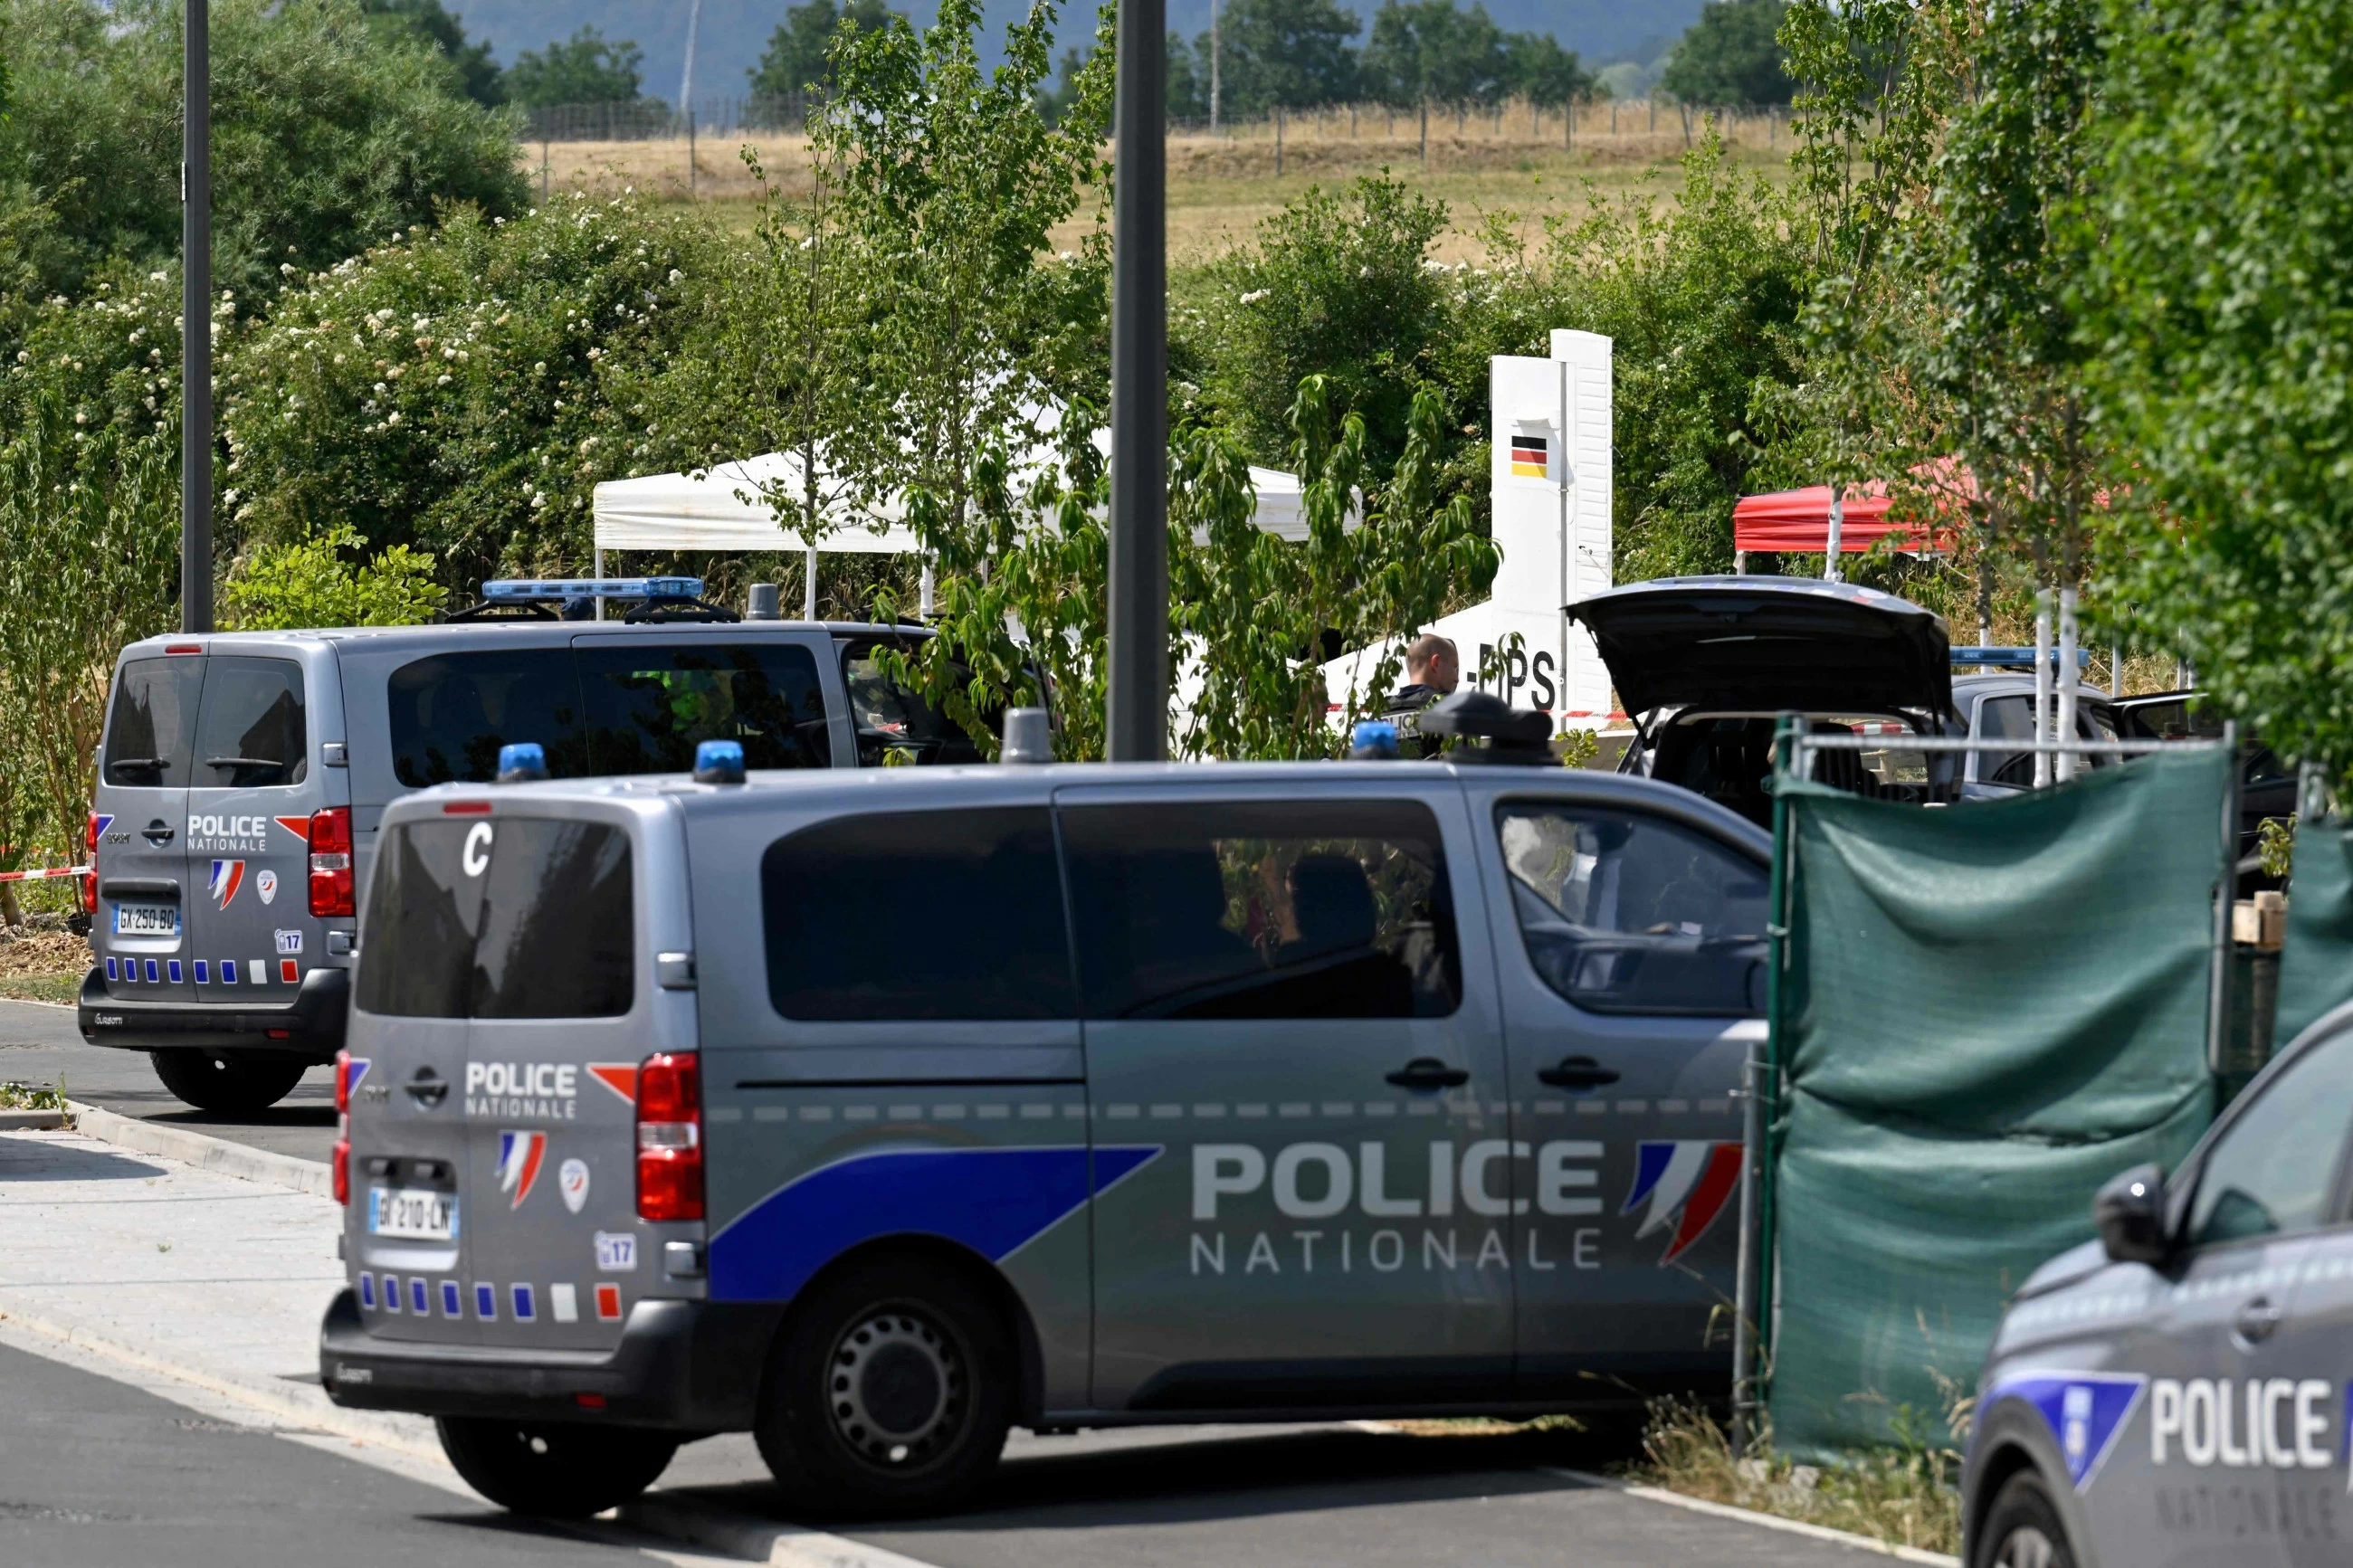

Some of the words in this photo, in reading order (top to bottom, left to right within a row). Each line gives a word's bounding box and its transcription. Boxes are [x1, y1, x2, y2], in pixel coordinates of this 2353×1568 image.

[188, 815, 266, 837] POLICE
[188, 838, 266, 851] NATIONALE
[462, 822, 492, 877] C
[285, 935, 300, 949] 17
[466, 1061, 577, 1098] POLICE
[465, 1097, 576, 1118] NATIONALE
[1193, 1140, 1605, 1220] POLICE
[612, 1241, 632, 1261] 17
[1191, 1228, 1601, 1275] NATIONALE
[2151, 1378, 2333, 1468] POLICE
